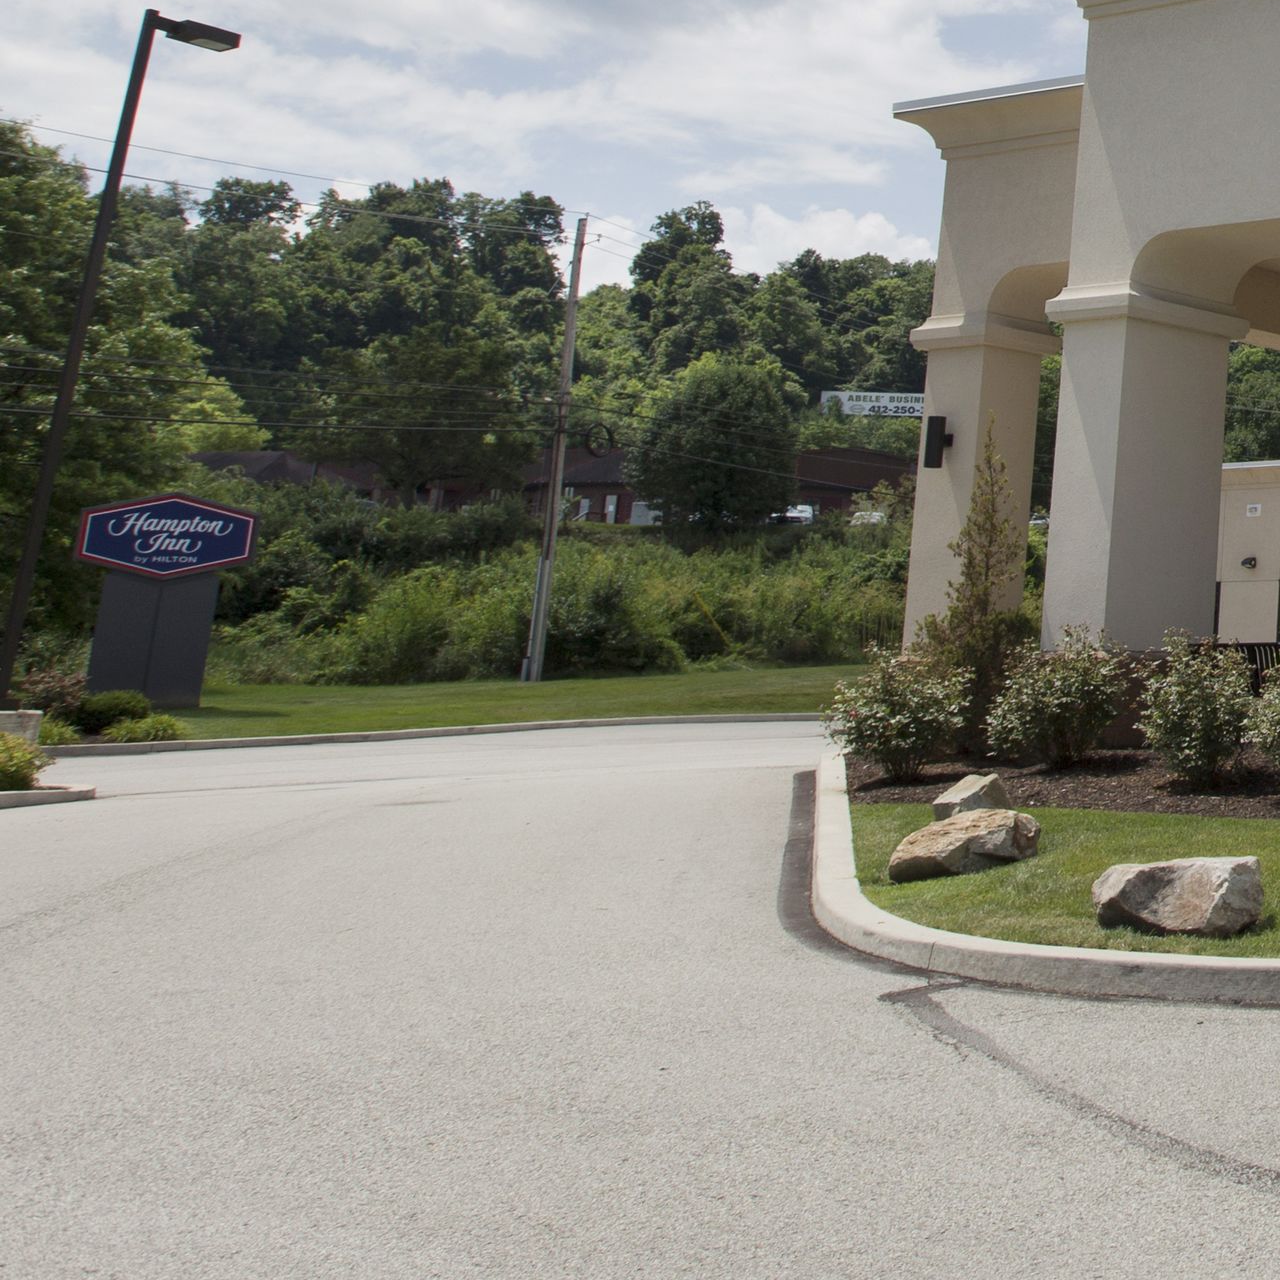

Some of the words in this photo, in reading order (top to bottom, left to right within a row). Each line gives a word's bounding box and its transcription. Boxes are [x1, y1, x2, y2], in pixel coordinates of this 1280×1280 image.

[108, 512, 233, 536] Hampton
[135, 533, 202, 554] Inn
[134, 556, 149, 564] by
